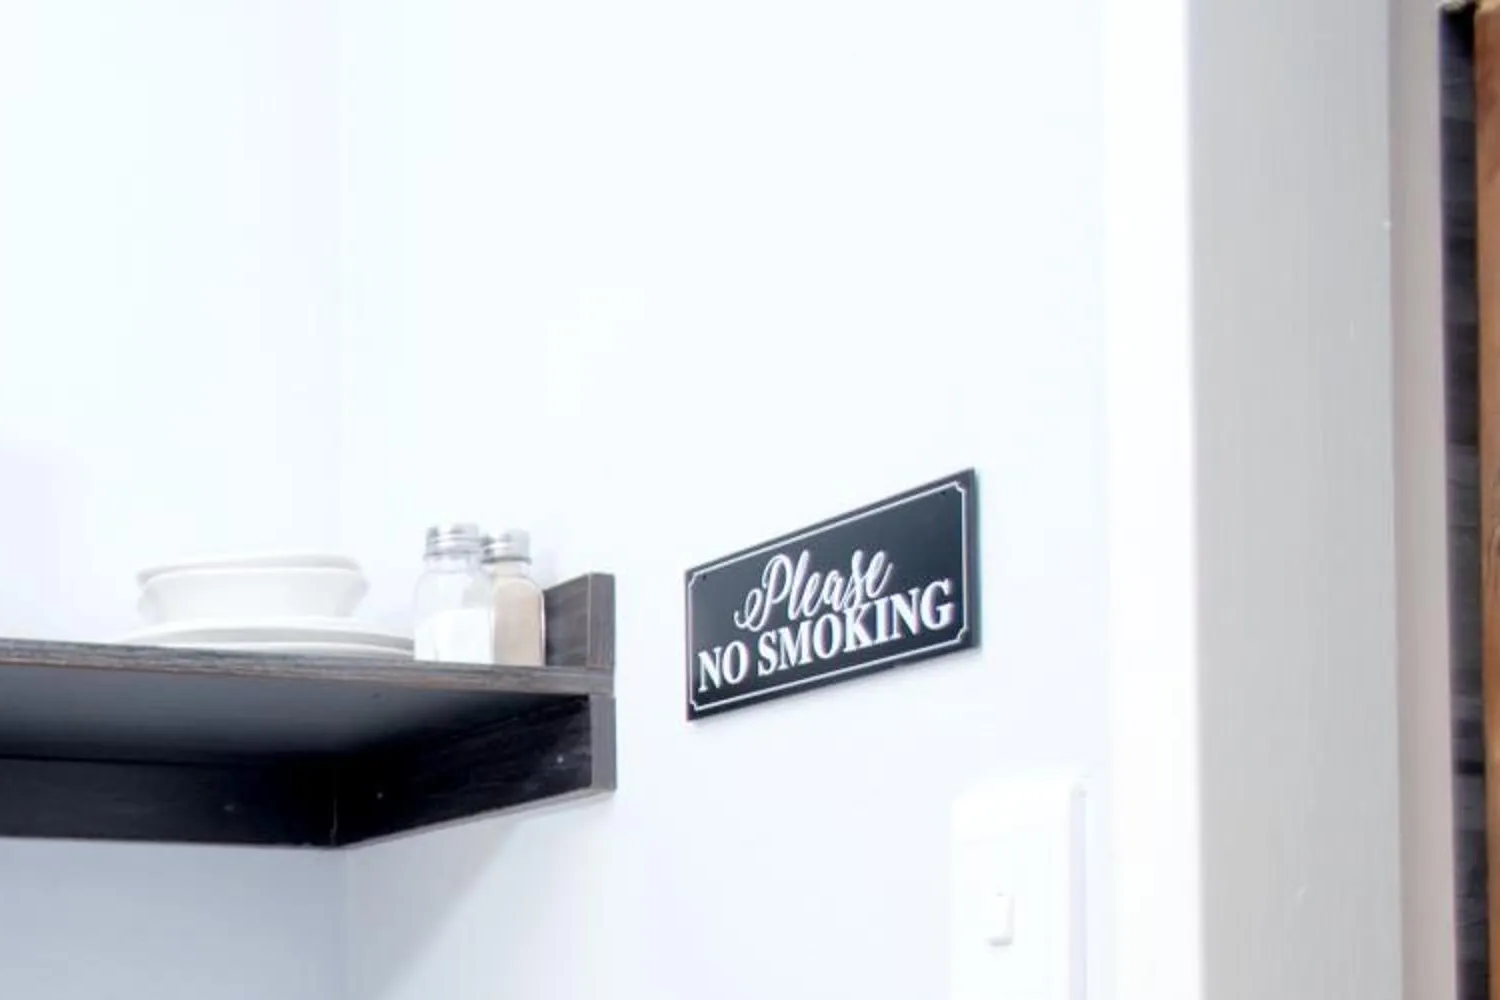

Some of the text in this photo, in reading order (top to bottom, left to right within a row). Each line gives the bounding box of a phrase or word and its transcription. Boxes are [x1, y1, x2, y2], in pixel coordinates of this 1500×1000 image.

[698, 578, 954, 693] NO SMOKING
[733, 550, 894, 632] Please
